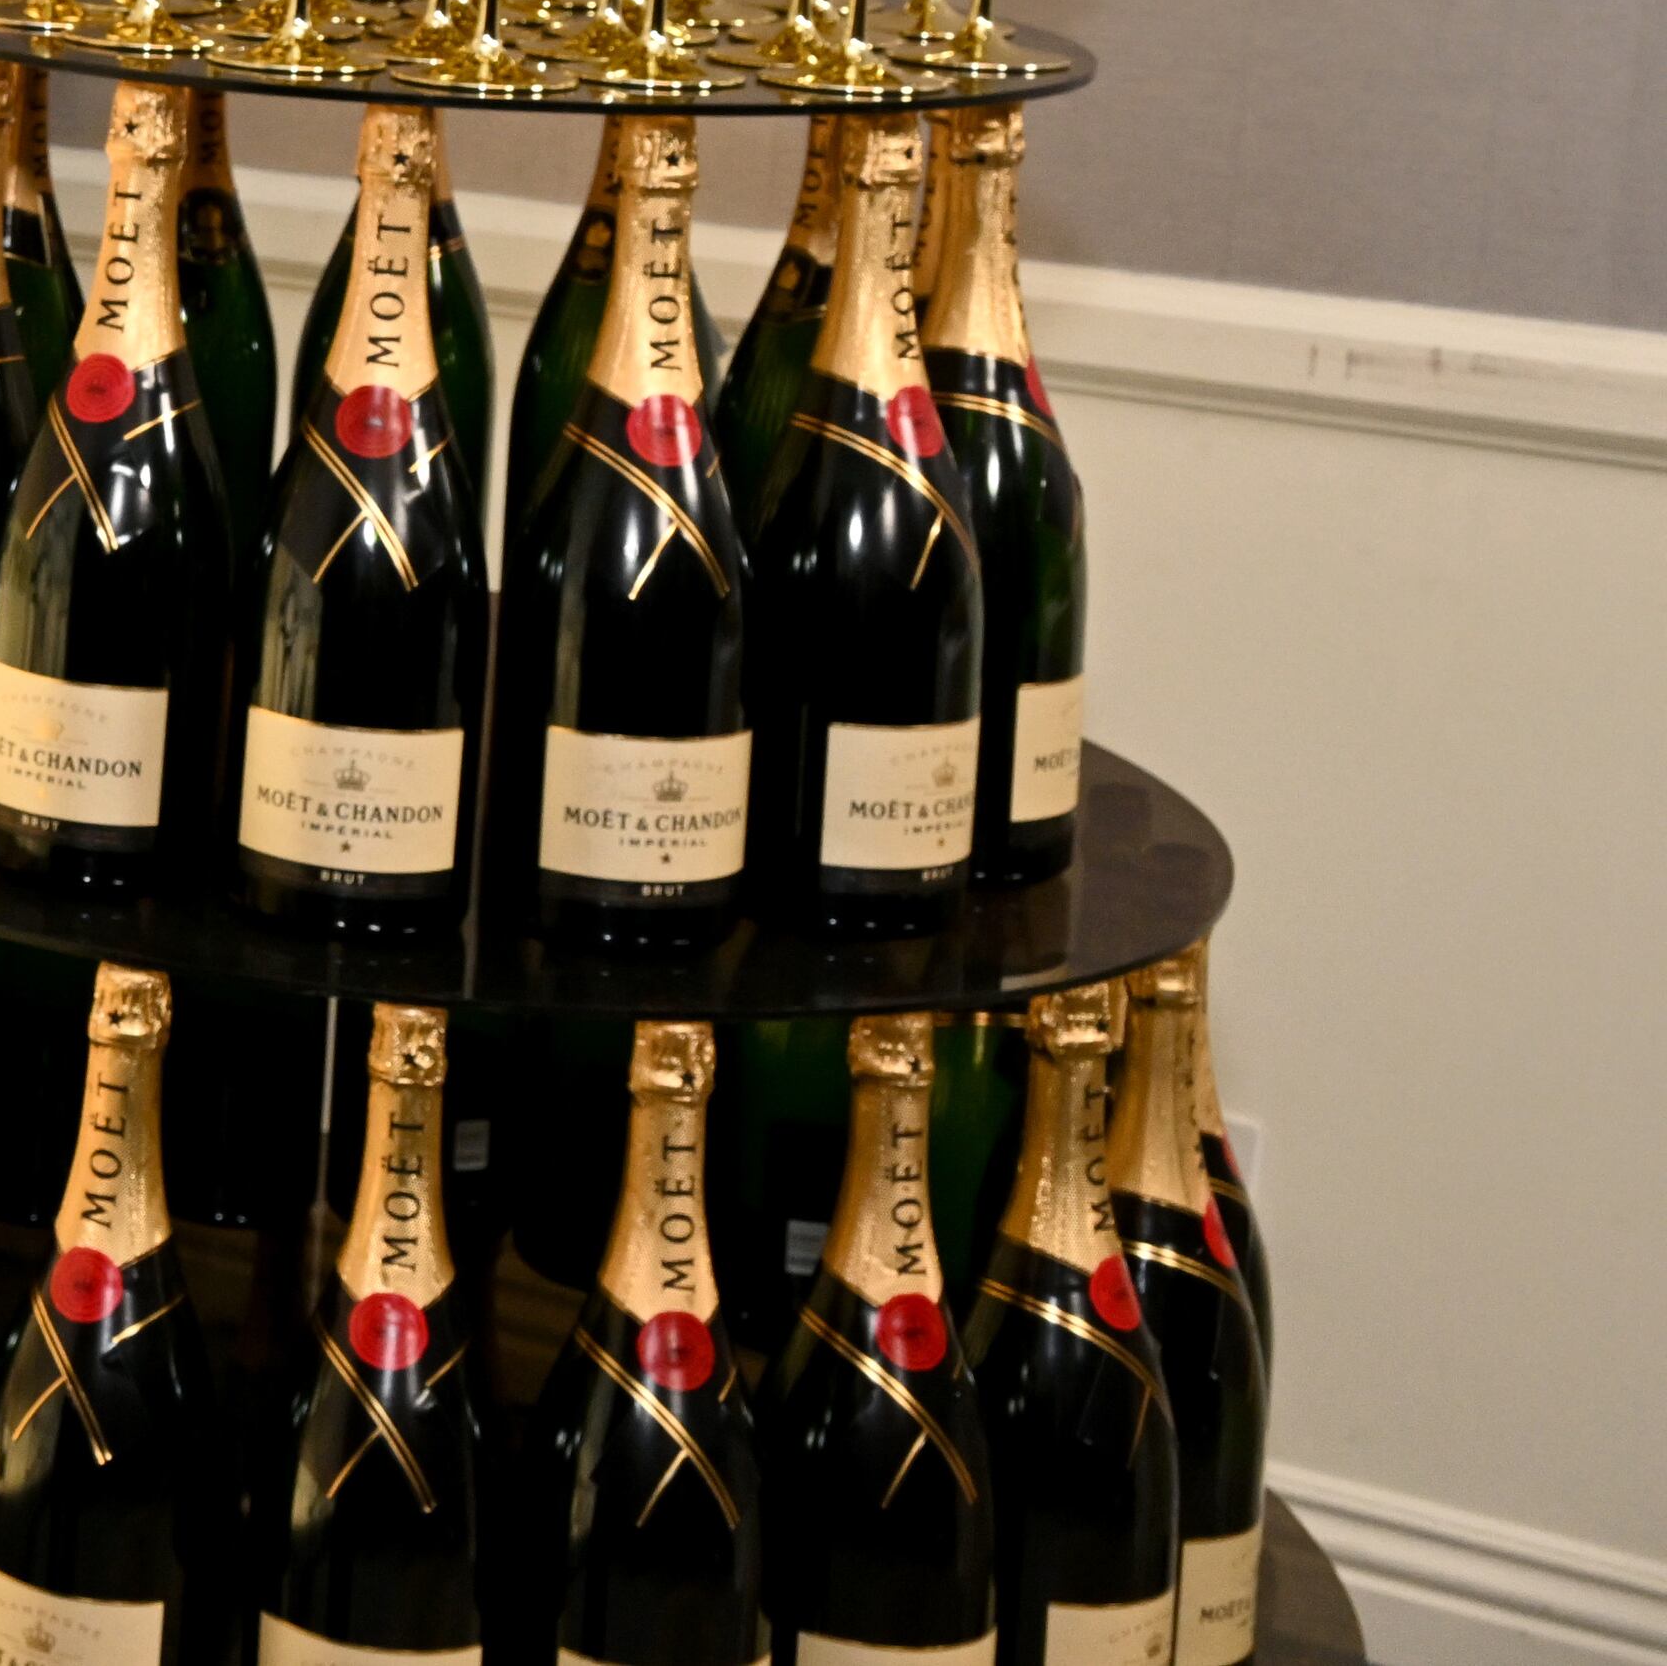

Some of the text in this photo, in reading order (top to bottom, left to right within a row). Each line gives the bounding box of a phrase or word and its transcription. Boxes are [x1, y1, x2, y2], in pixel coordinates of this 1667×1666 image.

[367, 213, 412, 369] MOËT
[643, 217, 685, 372] MOËT
[20, 750, 28, 763] &
[33, 751, 144, 779] CHANDON
[257, 784, 313, 814] MOËT
[317, 802, 328, 818] &
[334, 802, 444, 825] CHANDON
[563, 805, 743, 833] MOËT & CHANDON
[849, 799, 919, 820] MOËT
[919, 805, 929, 819] &
[20, 813, 61, 833] BRUT
[301, 821, 394, 840] IMPÉRIAL
[619, 837, 709, 849] IMPÉRIAL
[320, 869, 367, 886] BRUT
[641, 885, 685, 897] BRUT
[81, 1072, 129, 1230] MOËT
[381, 1112, 426, 1273] MOËT
[889, 1122, 927, 1278] MOËT
[654, 1133, 697, 1295] MOËT
